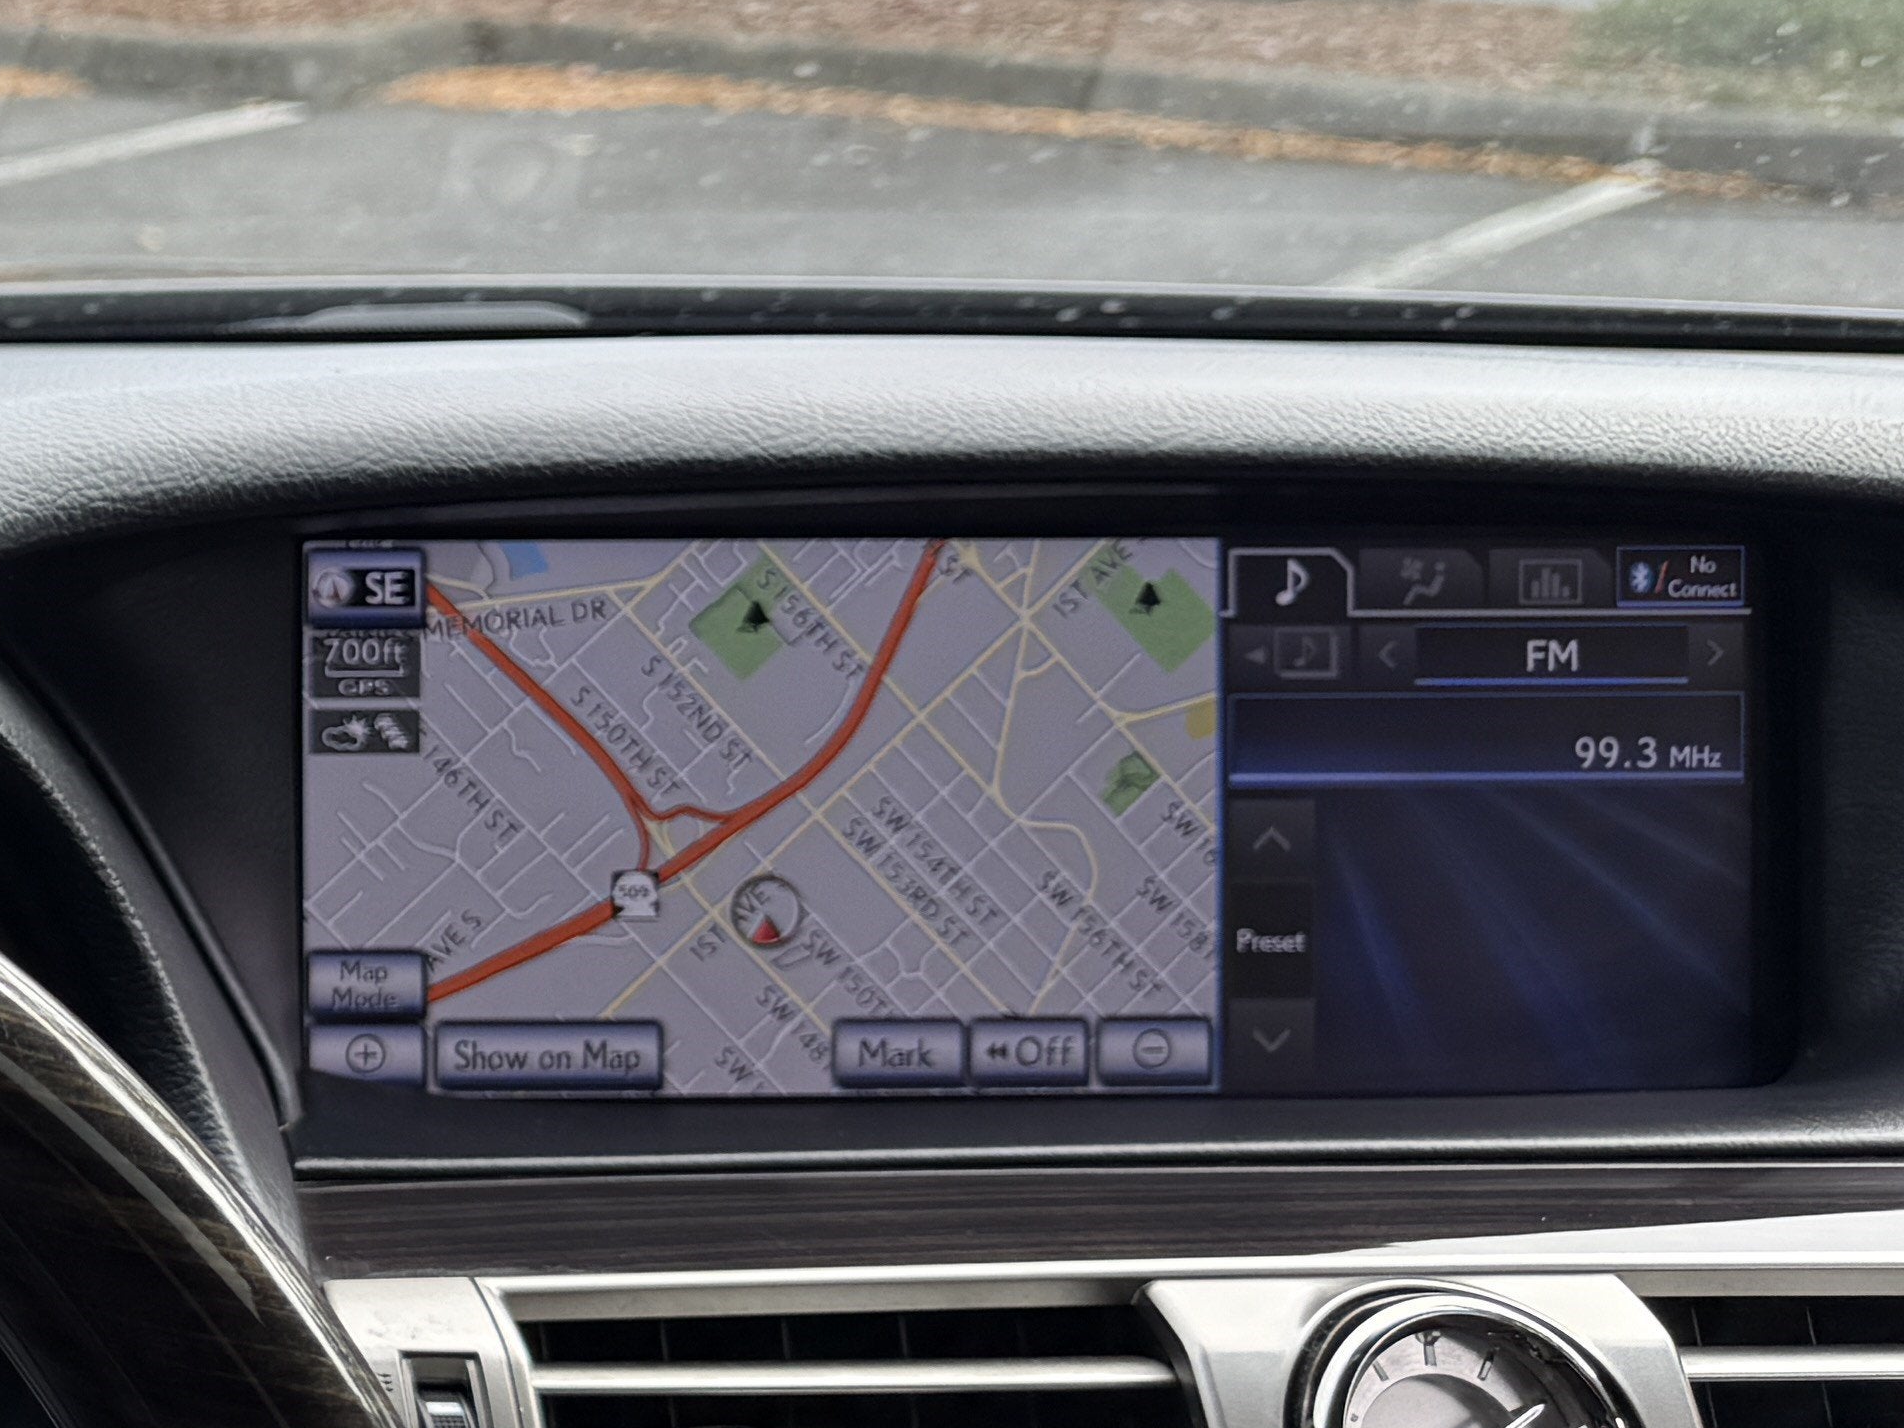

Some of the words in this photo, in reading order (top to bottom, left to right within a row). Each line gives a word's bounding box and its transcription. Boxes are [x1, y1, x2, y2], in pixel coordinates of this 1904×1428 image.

[1689, 556, 1717, 573] No
[365, 571, 408, 605] SE
[1666, 579, 1738, 599] Connect
[423, 606, 565, 641] MEMORIAL
[571, 599, 608, 621] DR
[323, 638, 407, 665] 700ft
[1526, 639, 1579, 672] FM
[1574, 736, 1660, 770] 99.3
[1670, 745, 1723, 770] MHz
[1237, 928, 1306, 952] Preset
[340, 960, 388, 984] Map
[331, 987, 397, 1009] Mode
[454, 1040, 528, 1071] Show
[539, 1047, 571, 1070] on
[583, 1040, 641, 1074] Map
[858, 1038, 935, 1068] Mark
[1015, 1035, 1074, 1066] Off
